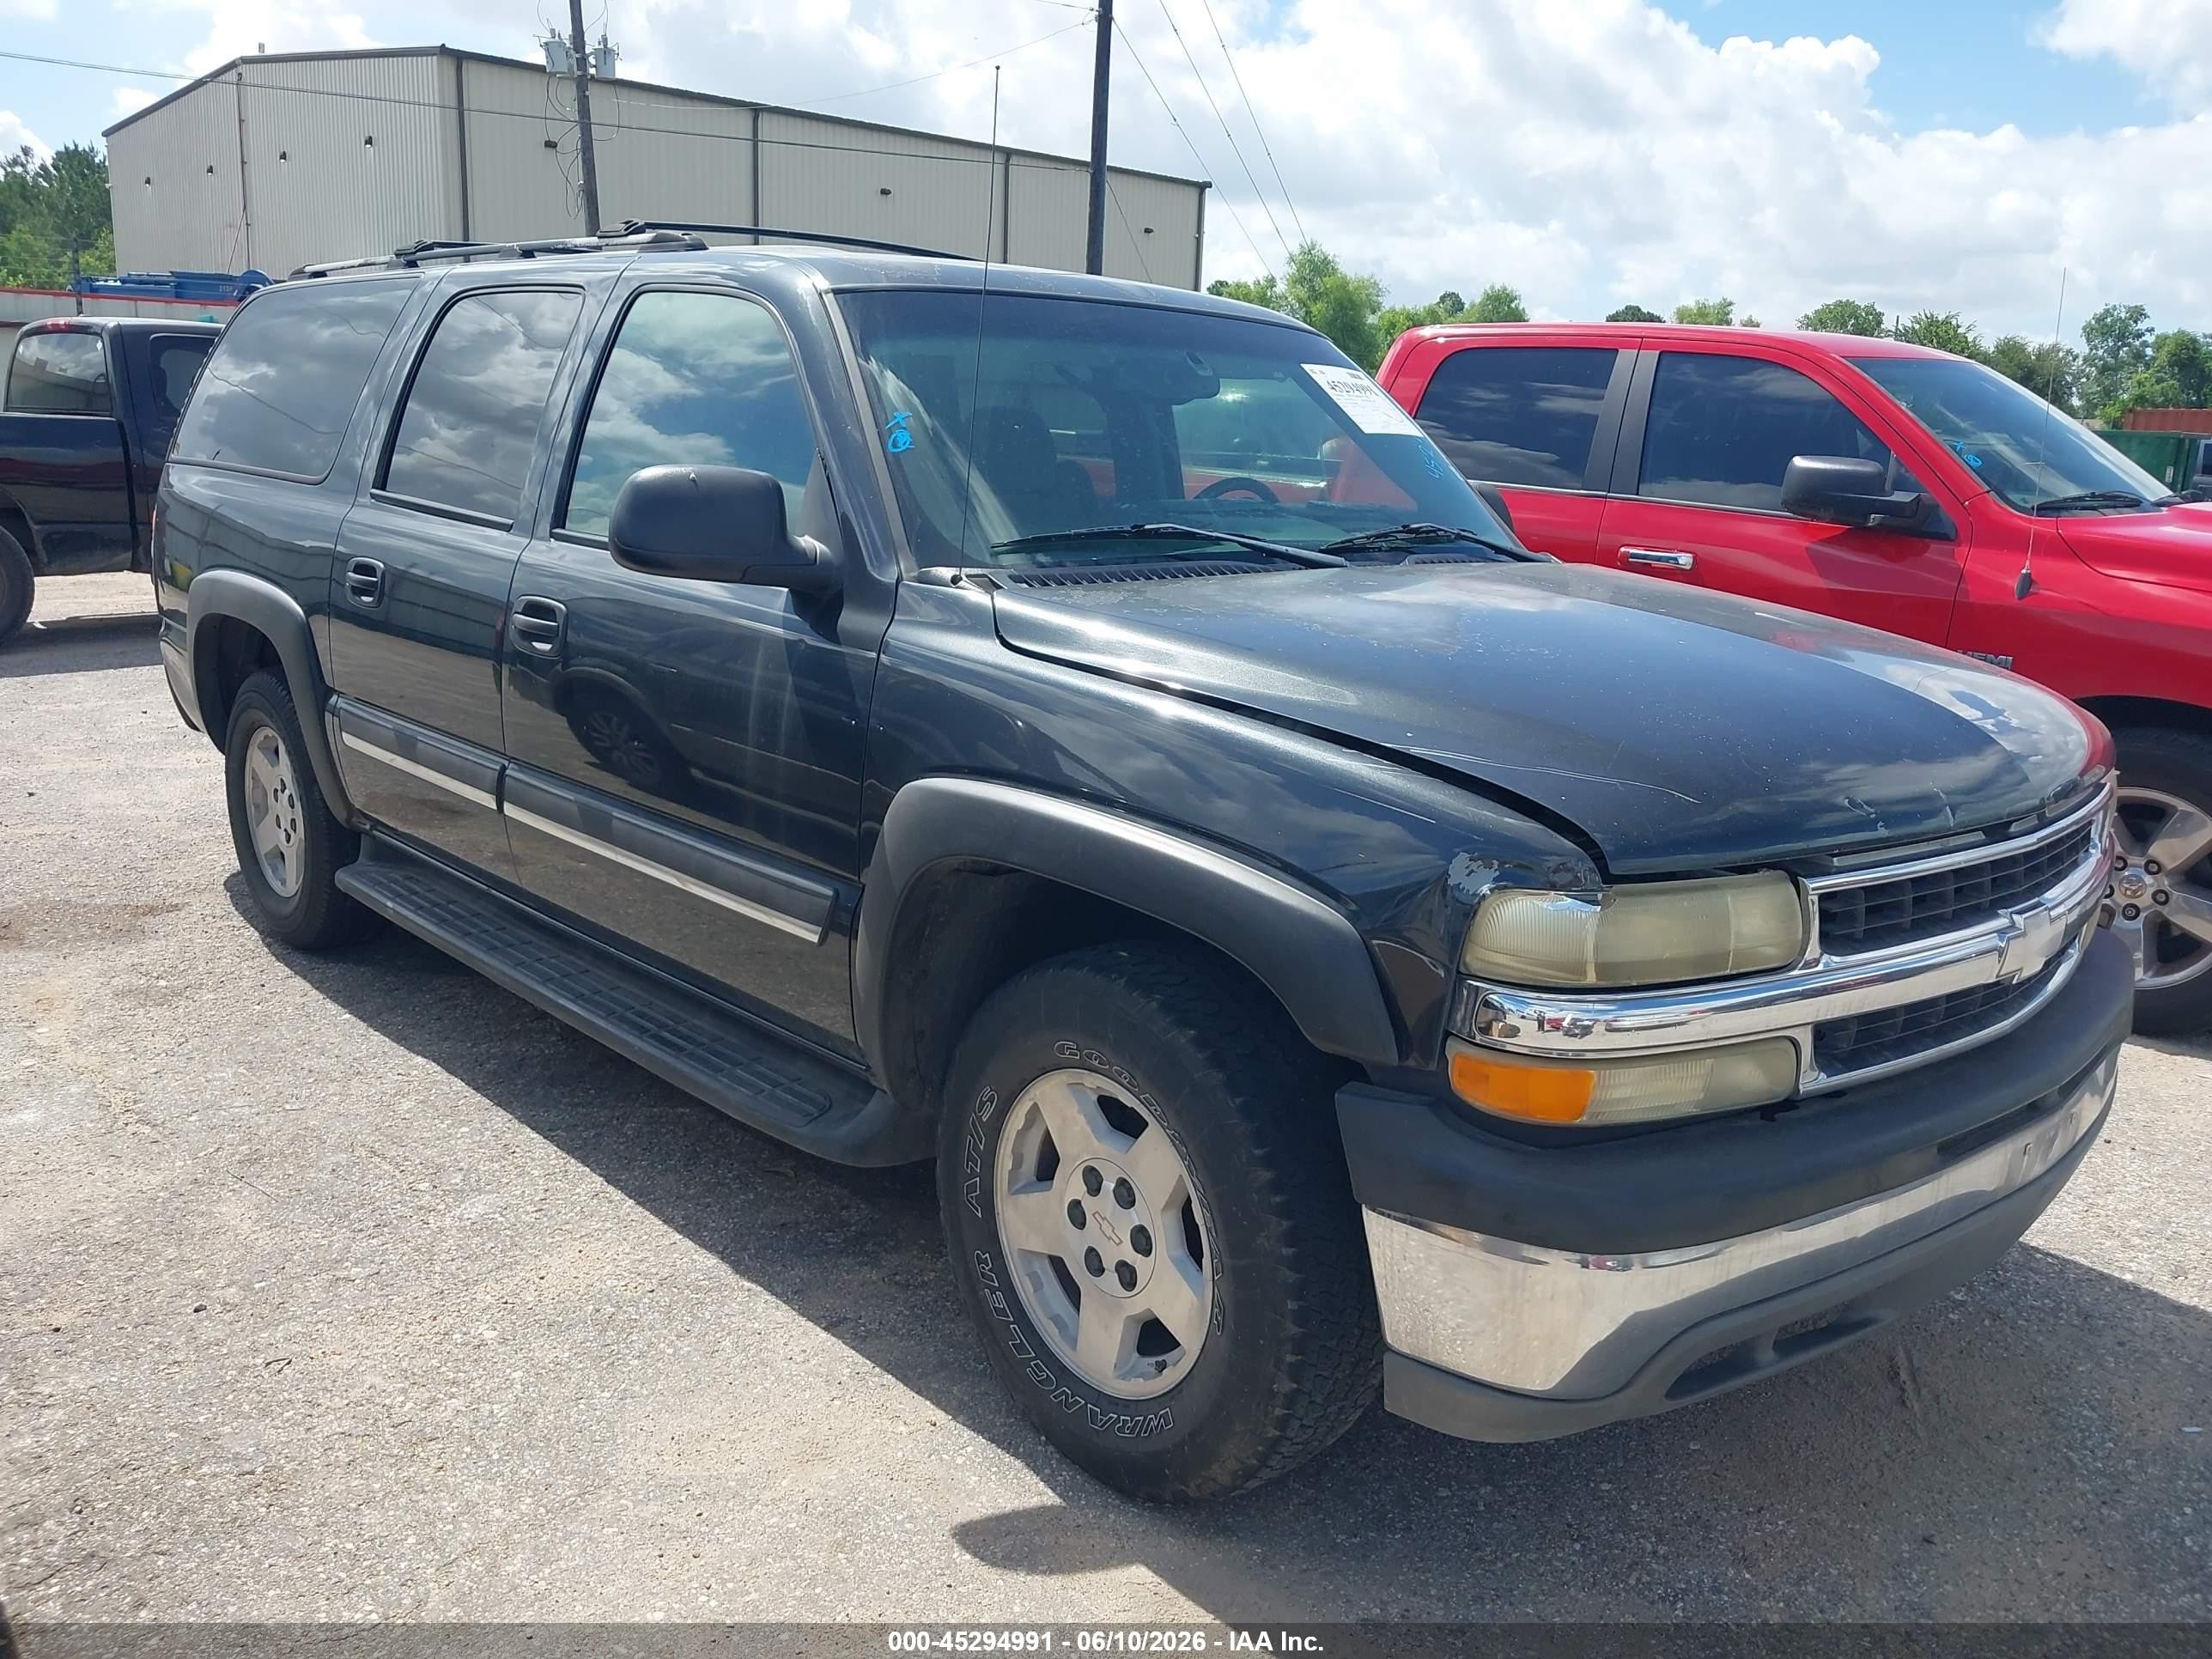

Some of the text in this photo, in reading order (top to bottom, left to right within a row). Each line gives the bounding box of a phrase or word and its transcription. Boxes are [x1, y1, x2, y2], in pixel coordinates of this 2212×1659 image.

[1326, 379, 1380, 398] 45294991
[963, 1085, 1175, 1437] WRANGLER AT/S
